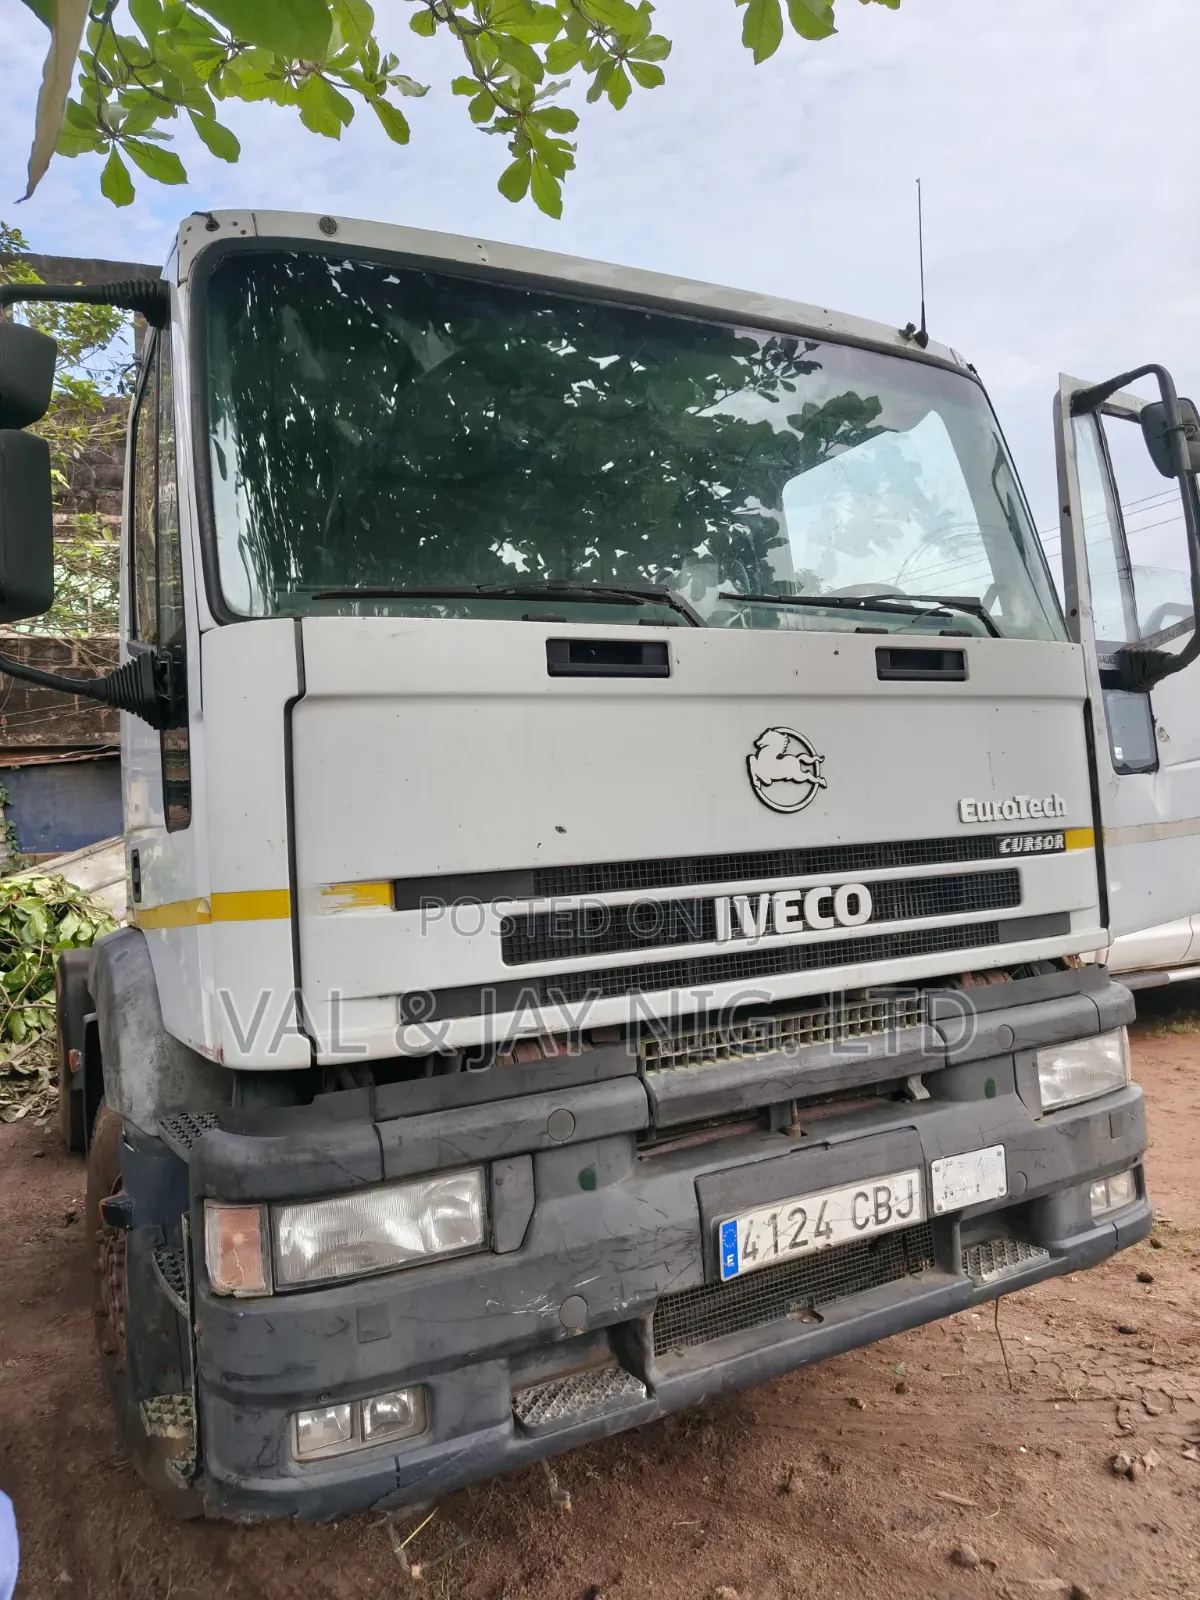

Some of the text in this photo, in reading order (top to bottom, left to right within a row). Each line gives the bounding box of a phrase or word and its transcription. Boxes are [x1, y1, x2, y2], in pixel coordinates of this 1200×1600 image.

[958, 794, 1066, 823] EuroTech
[999, 835, 1064, 854] CURSOR
[715, 883, 873, 941] IVECO
[742, 1199, 832, 1261] 4124
[852, 1179, 913, 1230] CBJ
[726, 1253, 735, 1268] E
